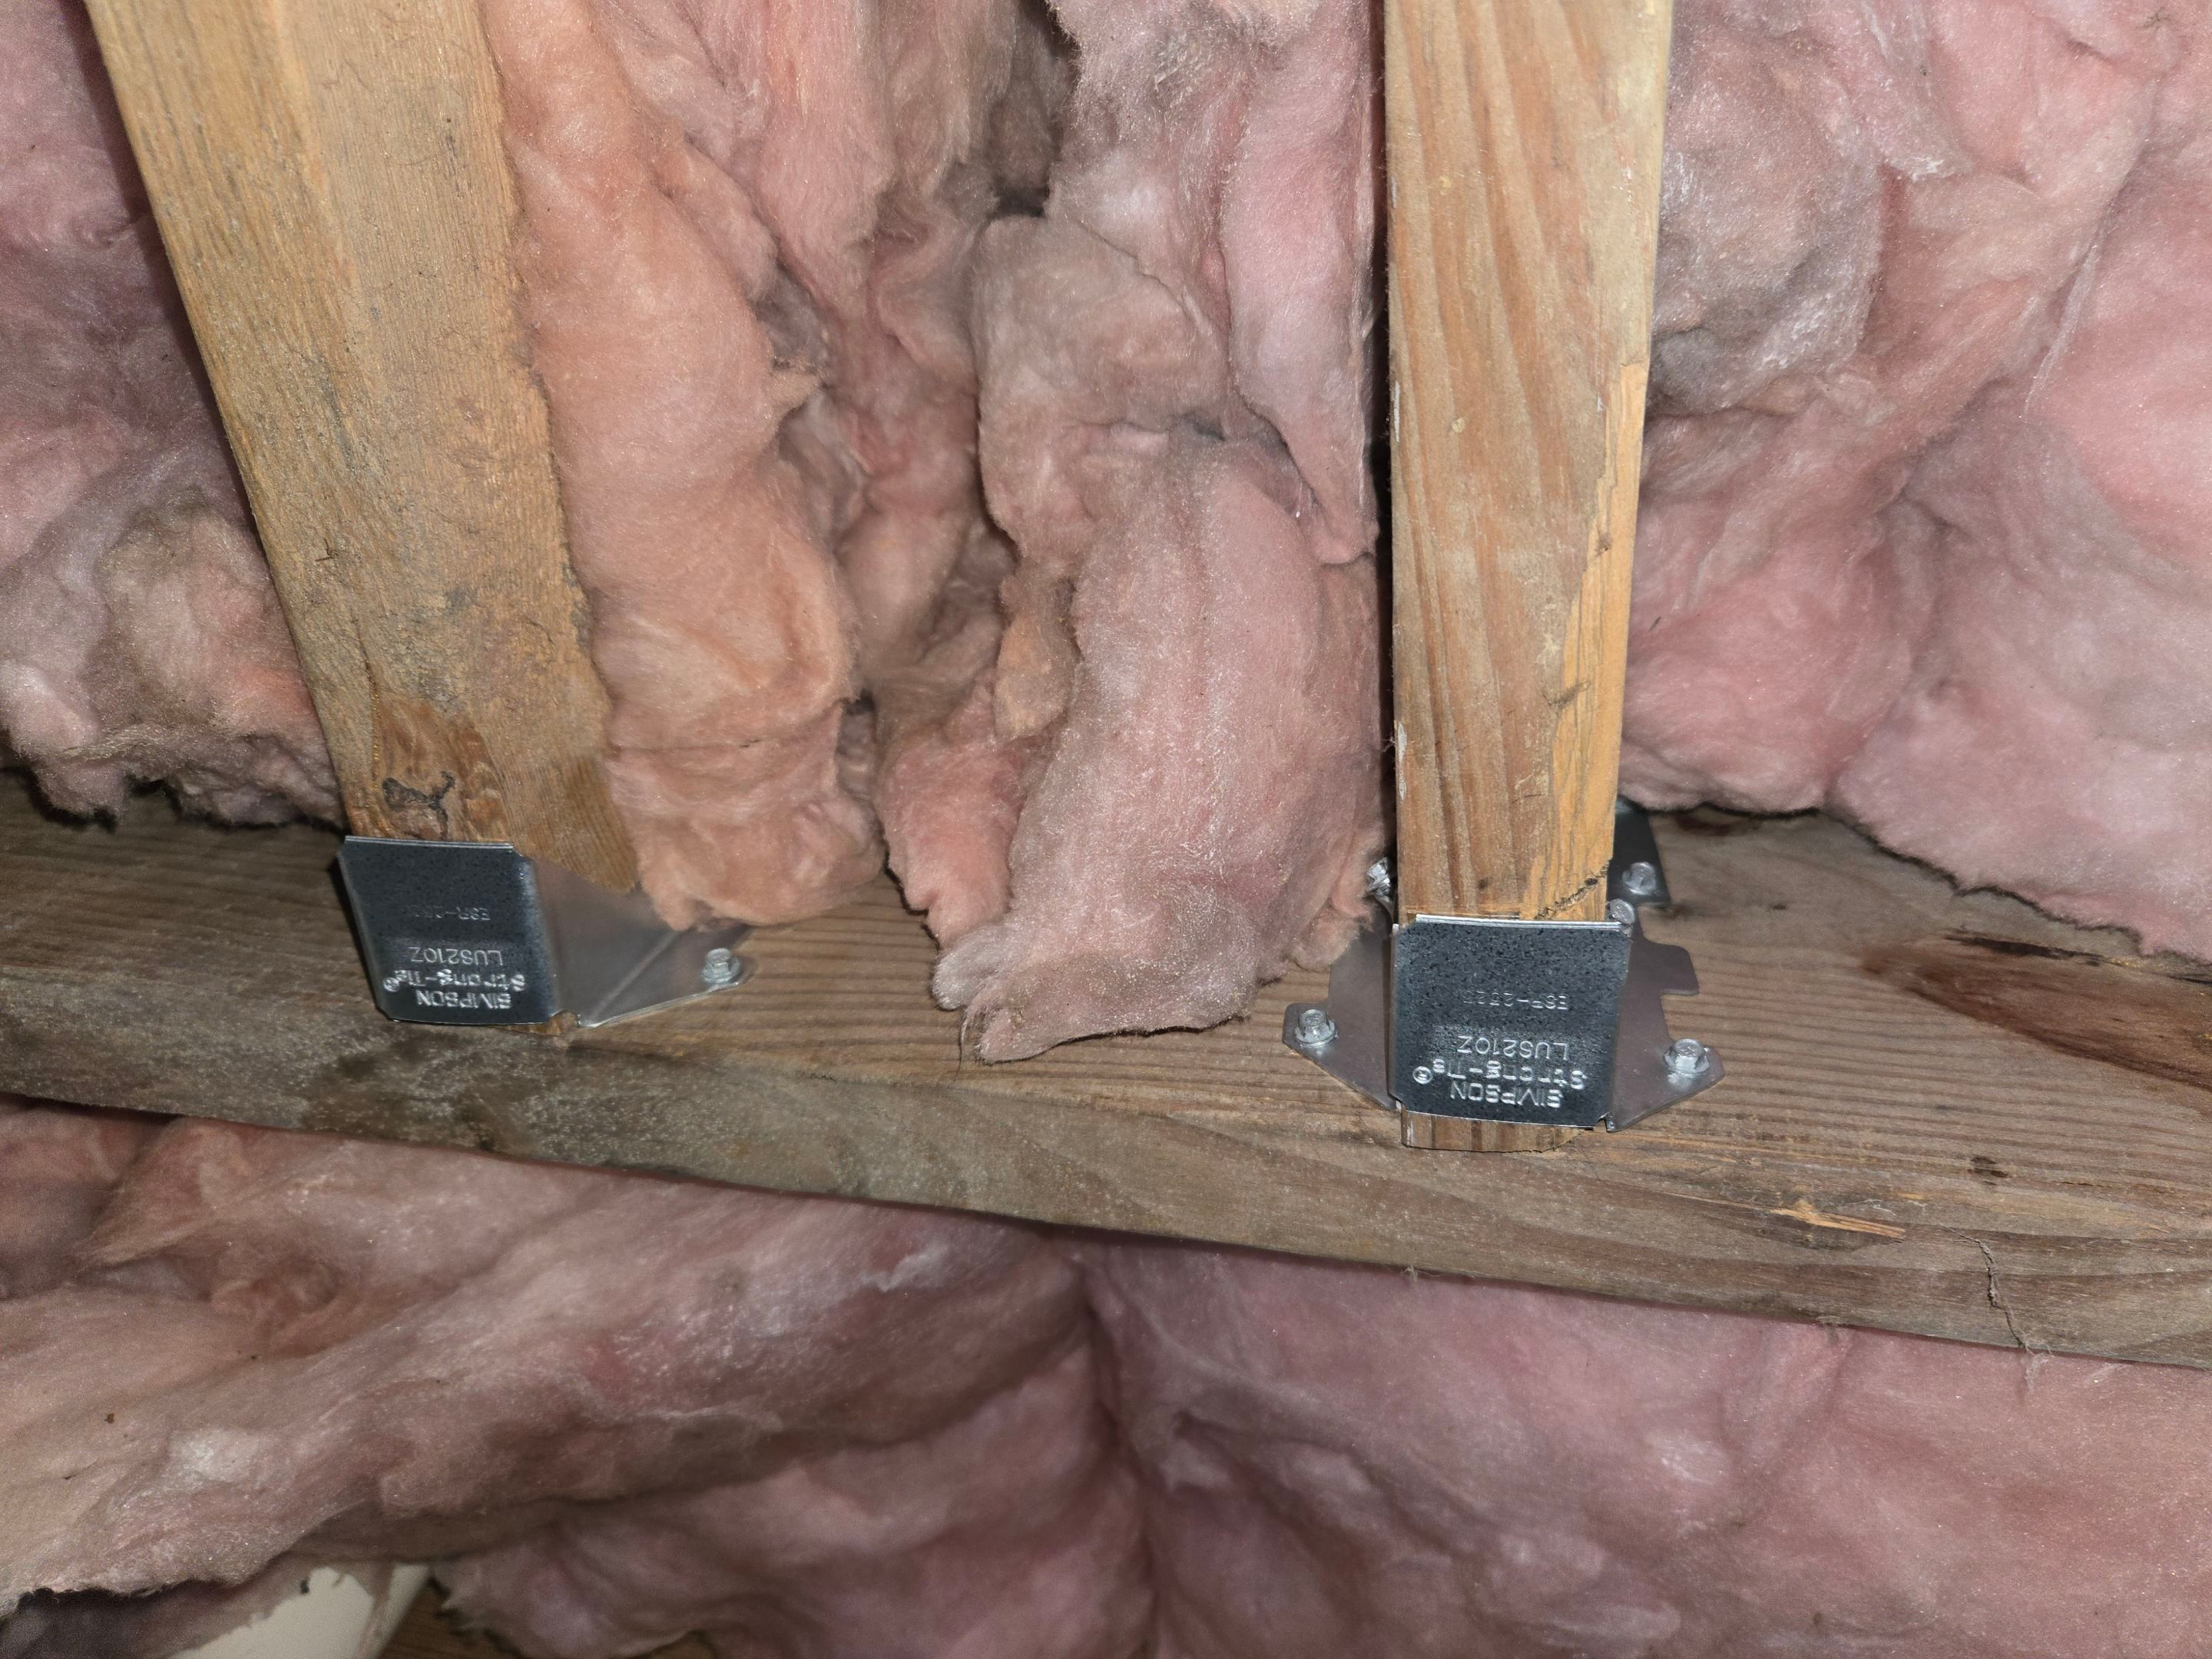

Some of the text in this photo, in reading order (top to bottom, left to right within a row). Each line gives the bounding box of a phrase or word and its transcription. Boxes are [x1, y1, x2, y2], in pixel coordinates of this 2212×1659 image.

[408, 946, 503, 966] LUS210Z
[416, 990, 512, 1009] SIMPSON
[1457, 1035, 1568, 1059] LUS210Z
[1450, 1081, 1564, 1108] SIMPSON
